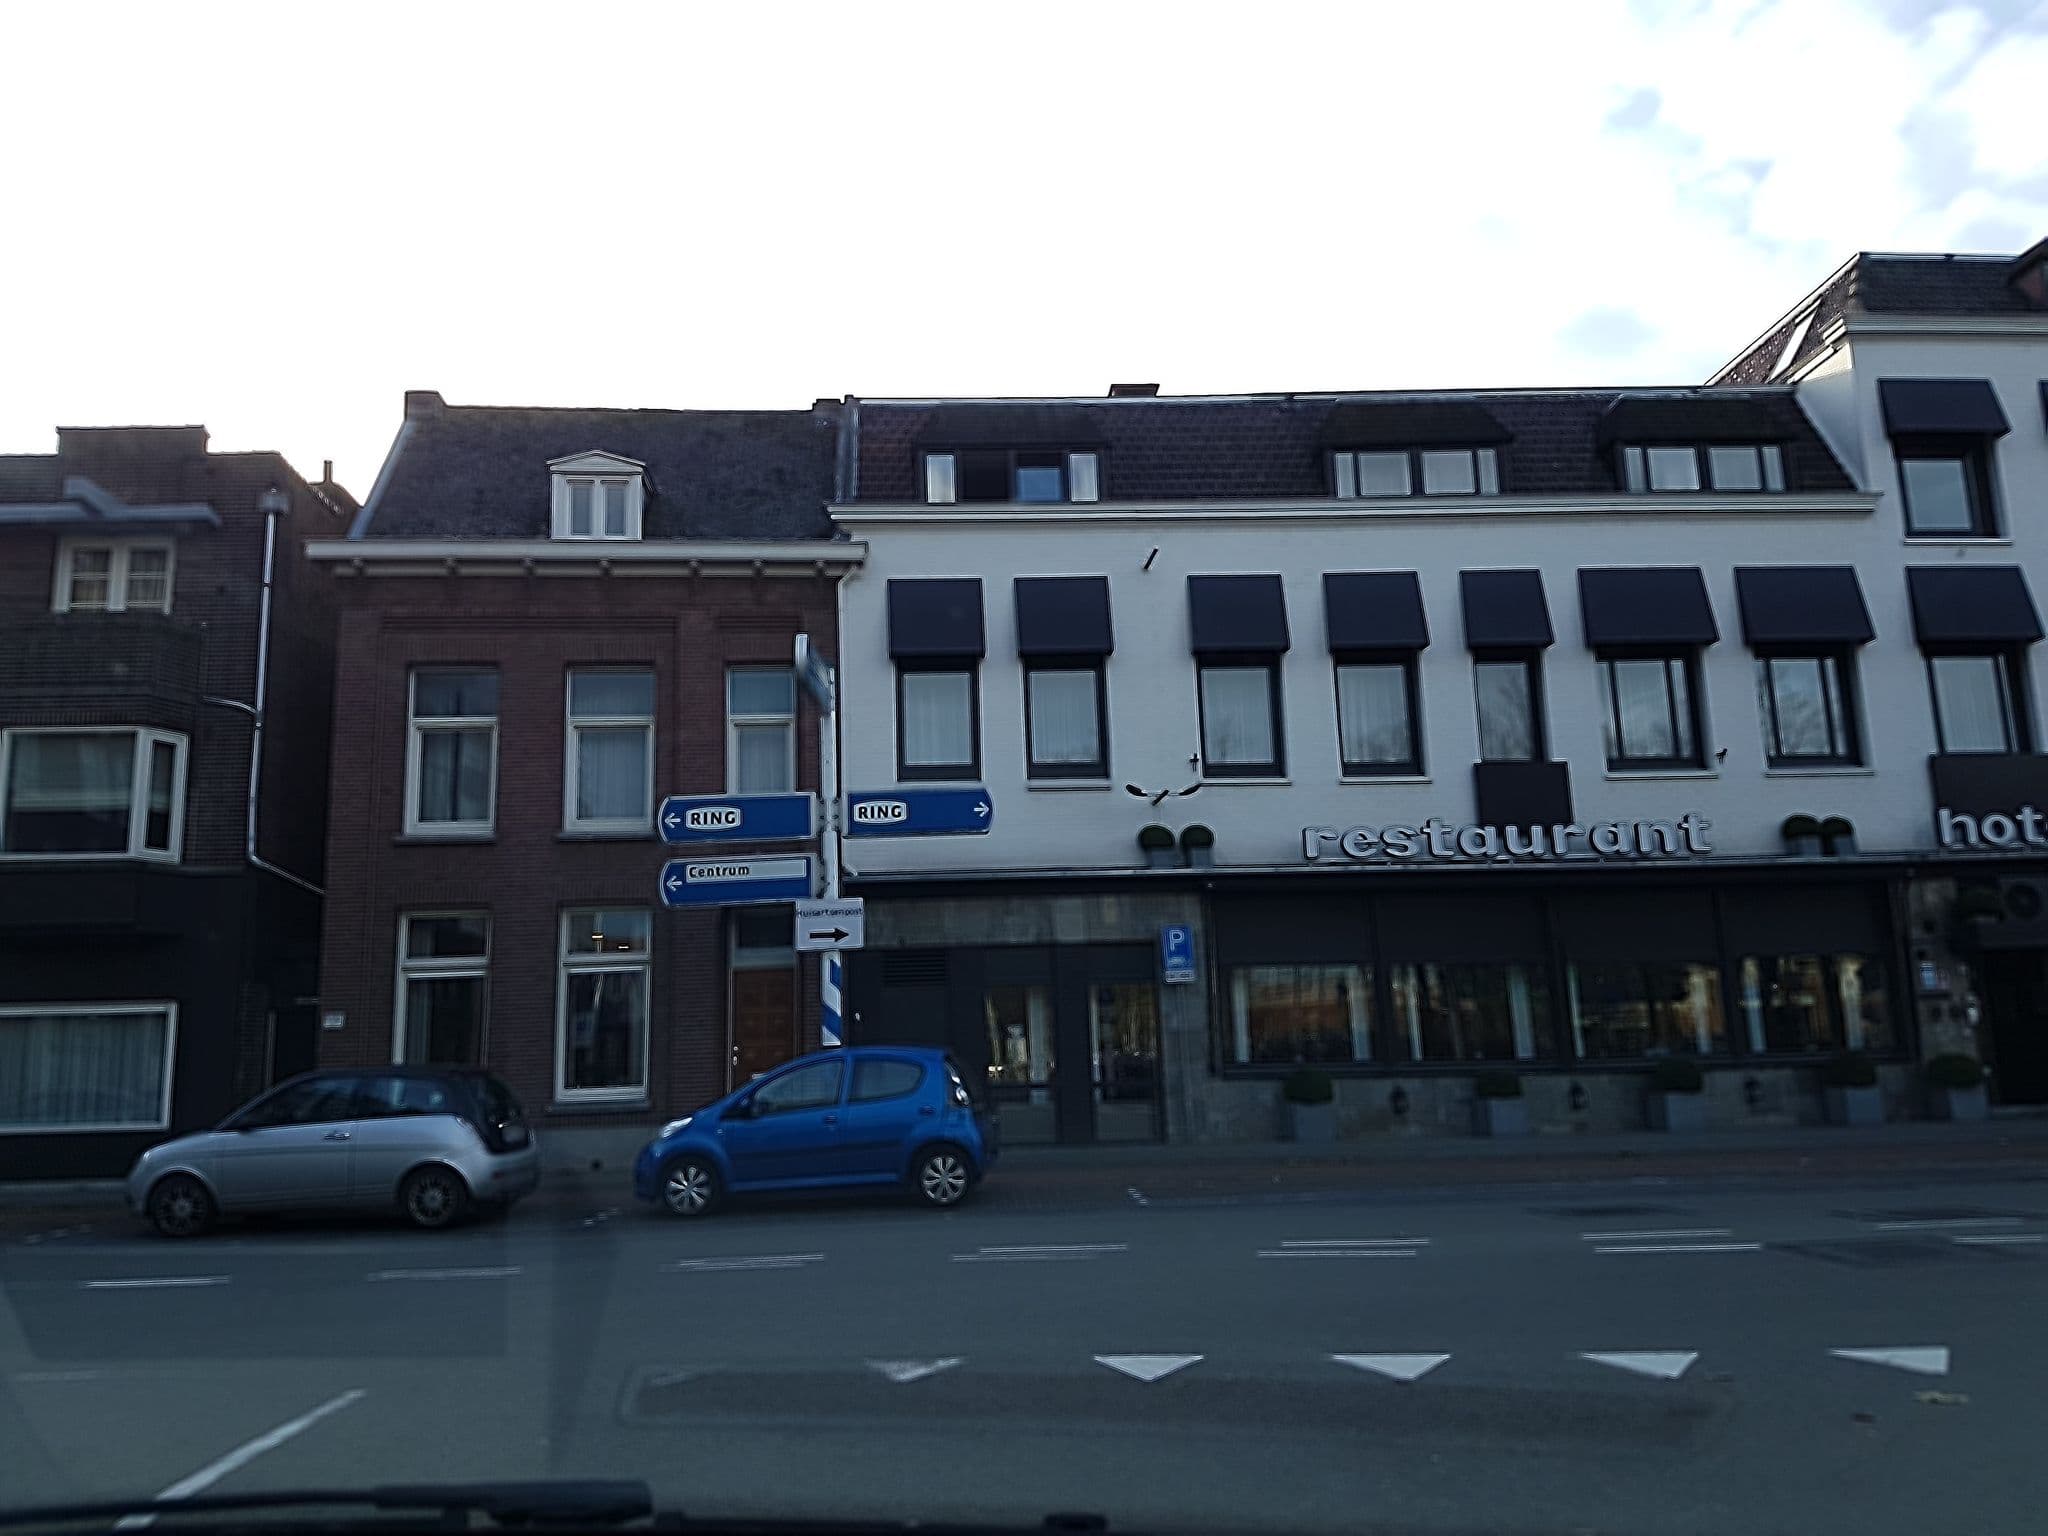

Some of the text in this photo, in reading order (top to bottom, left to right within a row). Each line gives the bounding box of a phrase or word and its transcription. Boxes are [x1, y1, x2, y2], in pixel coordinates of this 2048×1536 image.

[691, 810, 736, 825] RING
[858, 805, 902, 819] RING
[1302, 813, 1712, 857] restaurant
[1938, 807, 2048, 844] hot
[688, 865, 749, 878] Centrum
[1169, 929, 1185, 952] P
